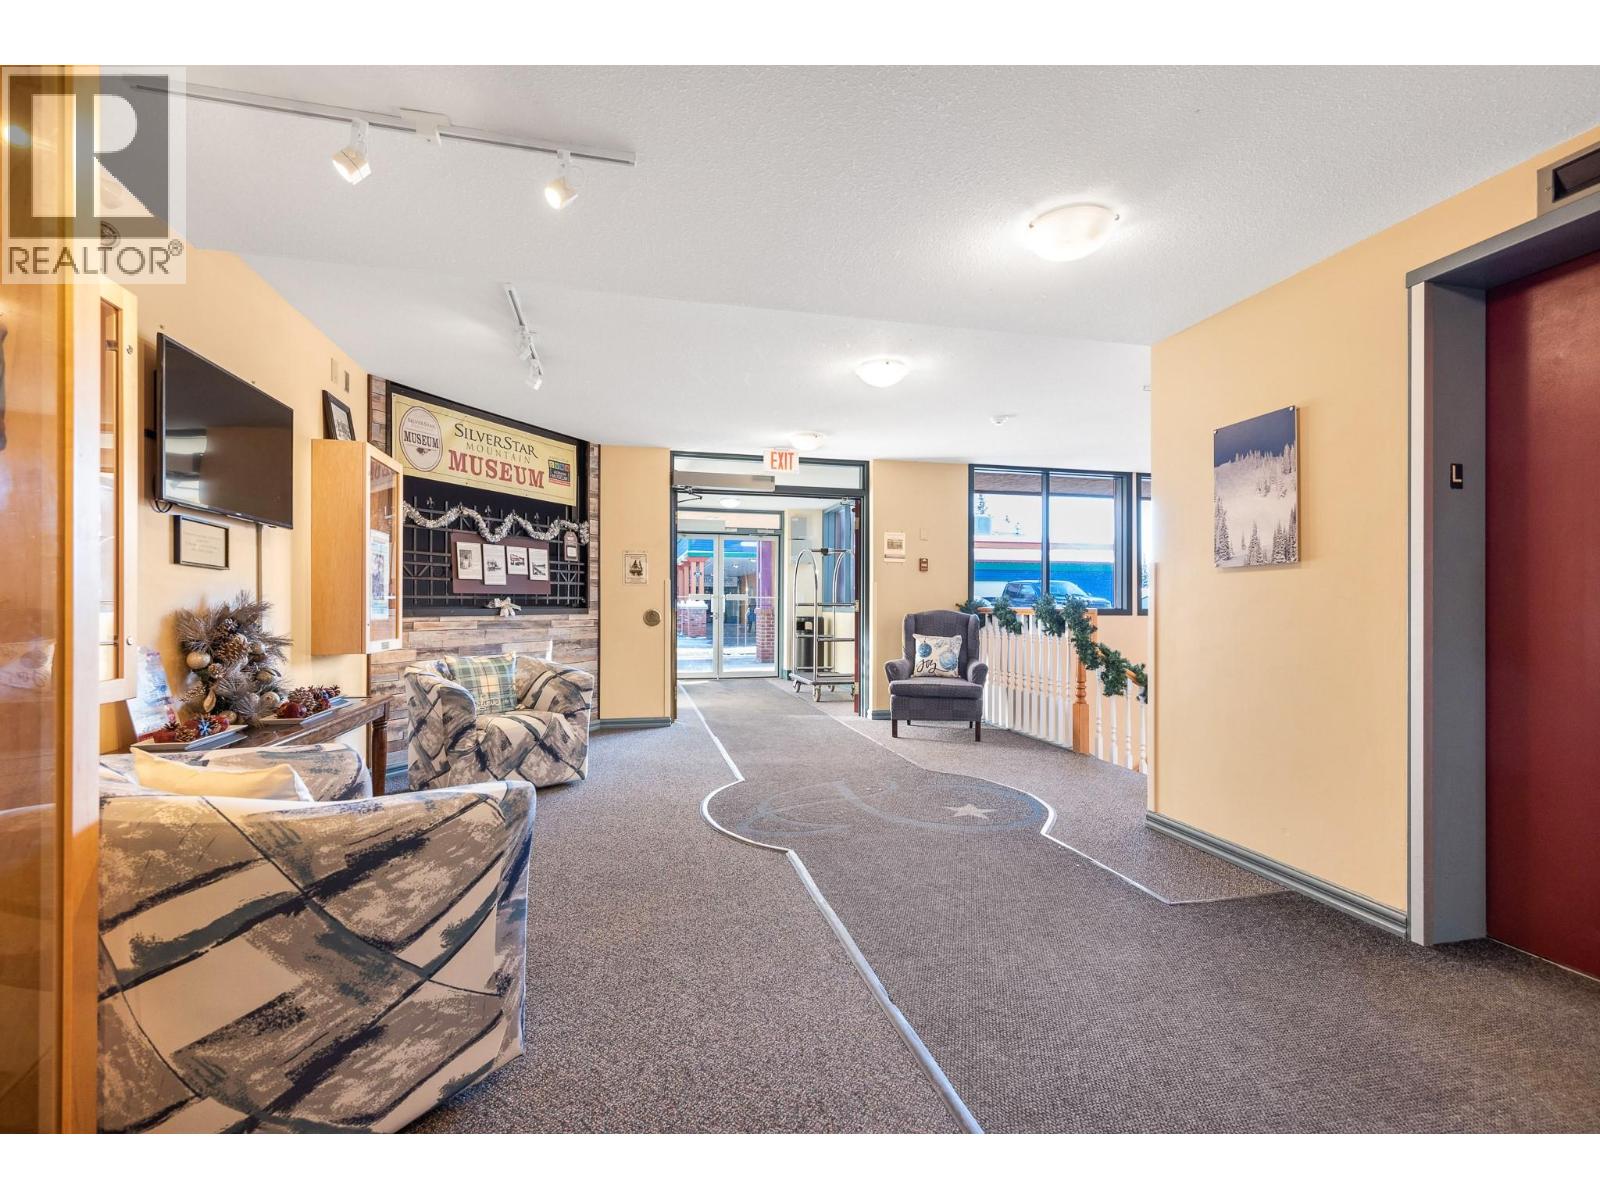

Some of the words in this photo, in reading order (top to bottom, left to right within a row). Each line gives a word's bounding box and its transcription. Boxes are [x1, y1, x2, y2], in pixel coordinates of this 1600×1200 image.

[403, 430, 439, 449] MUSEUM
[466, 442, 530, 464] MOUNTAIN
[770, 451, 795, 471] EXIT
[448, 449, 545, 489] MUSEUM
[1452, 464, 1462, 483] L
